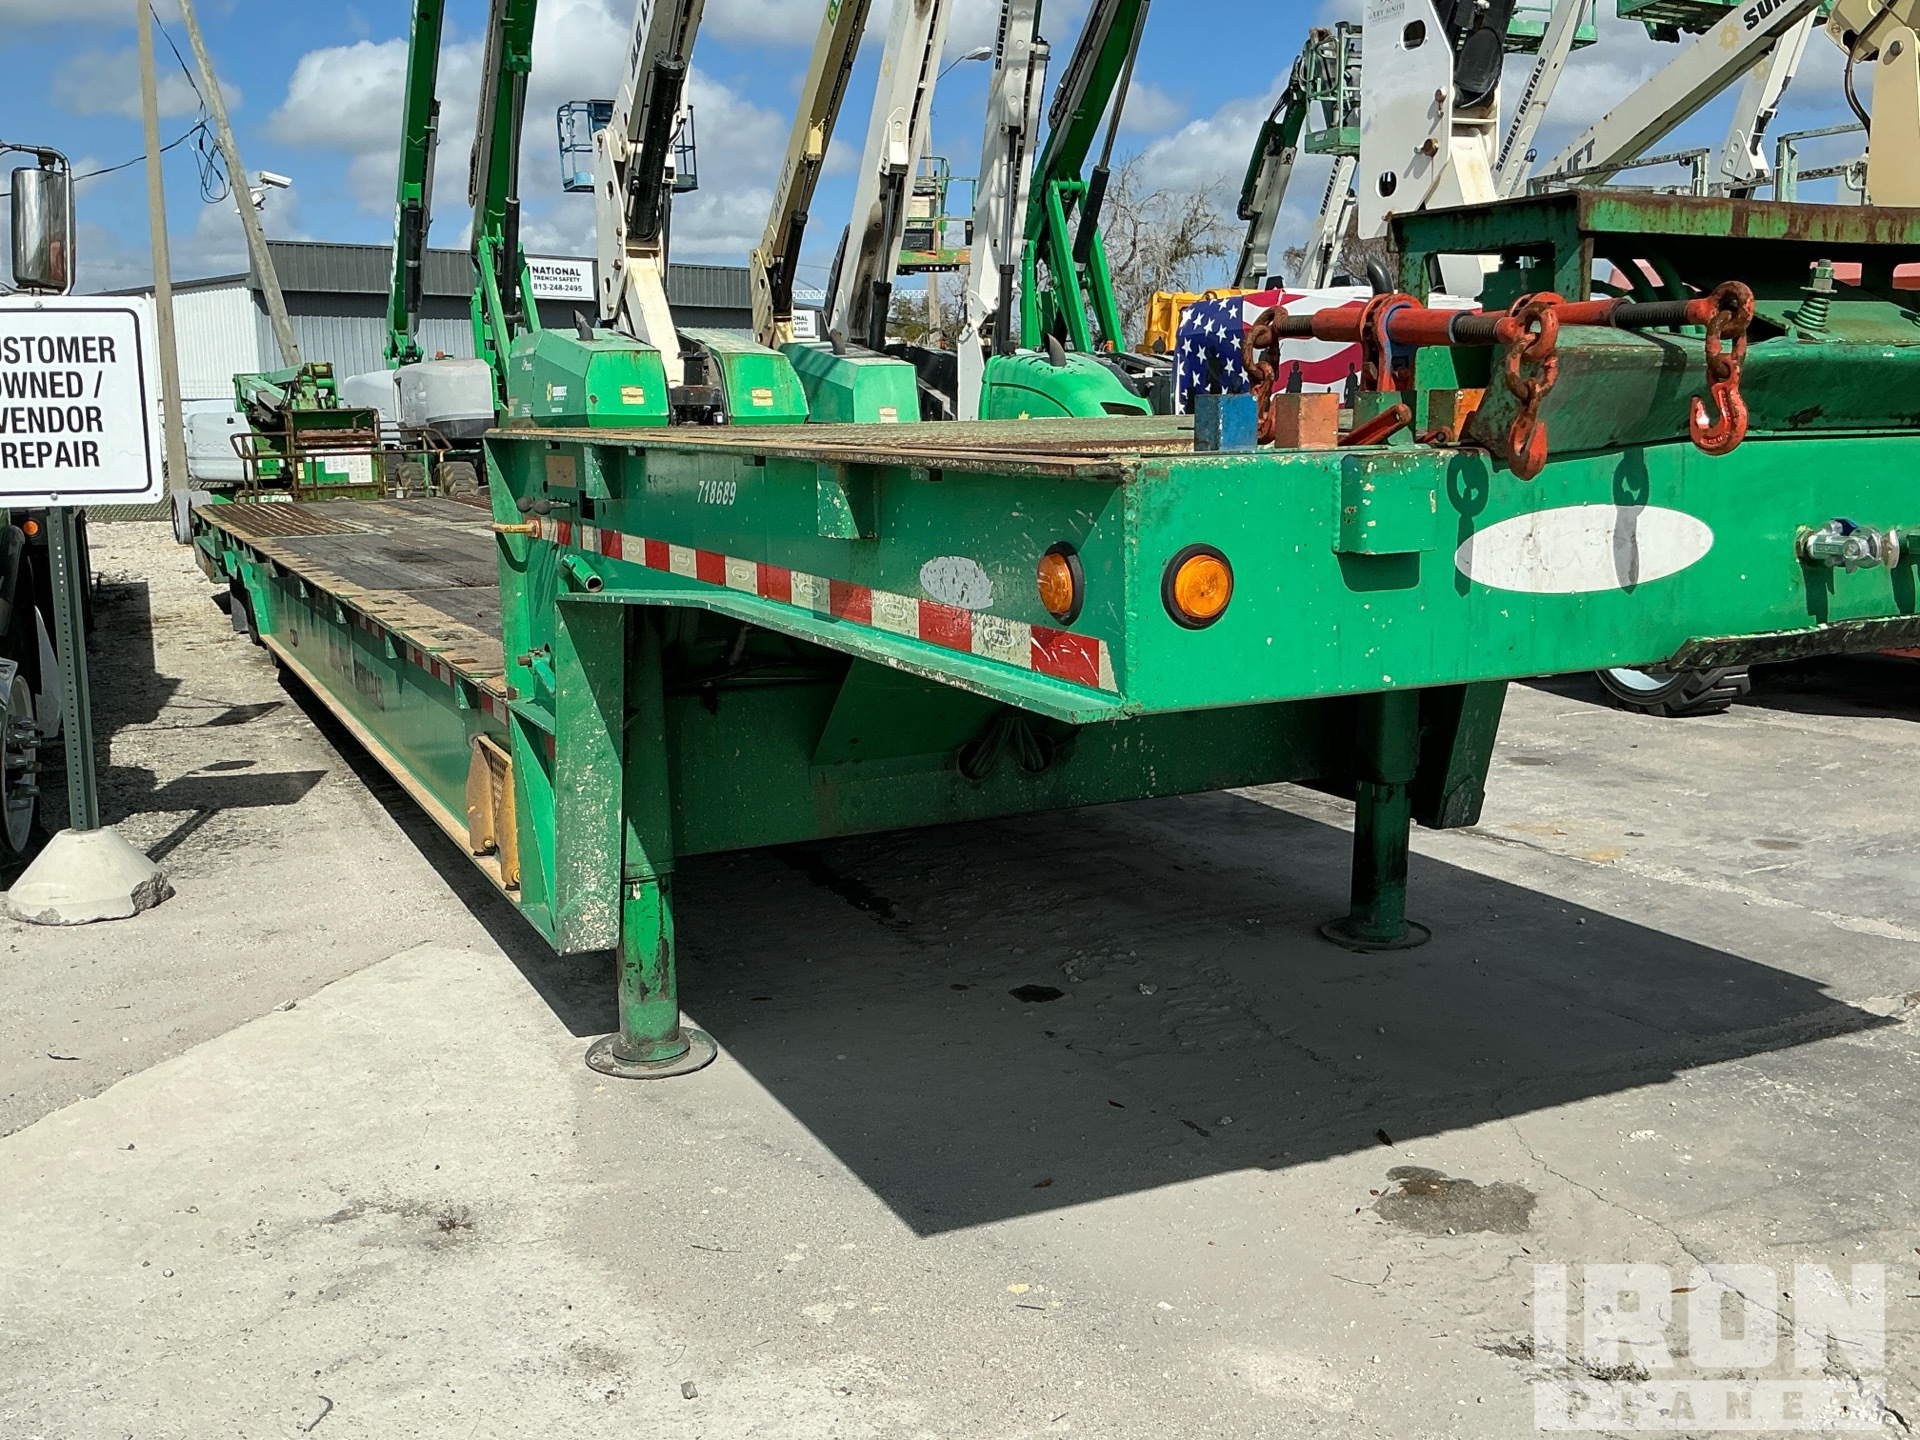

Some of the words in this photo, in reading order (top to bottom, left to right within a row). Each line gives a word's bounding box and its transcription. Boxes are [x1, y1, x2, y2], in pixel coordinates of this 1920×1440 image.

[1495, 116, 1522, 172] SUNBELT
[1518, 57, 1546, 115] RENTALS
[1320, 168, 1337, 217] SUNBELT
[532, 266, 581, 276] NATIONAL
[533, 283, 583, 292] 813-248-2495
[0, 336, 117, 364] STOMER
[0, 371, 83, 399] WNED
[93, 370, 103, 399] /
[1, 441, 100, 469] REPAIR
[697, 480, 737, 506] 718689
